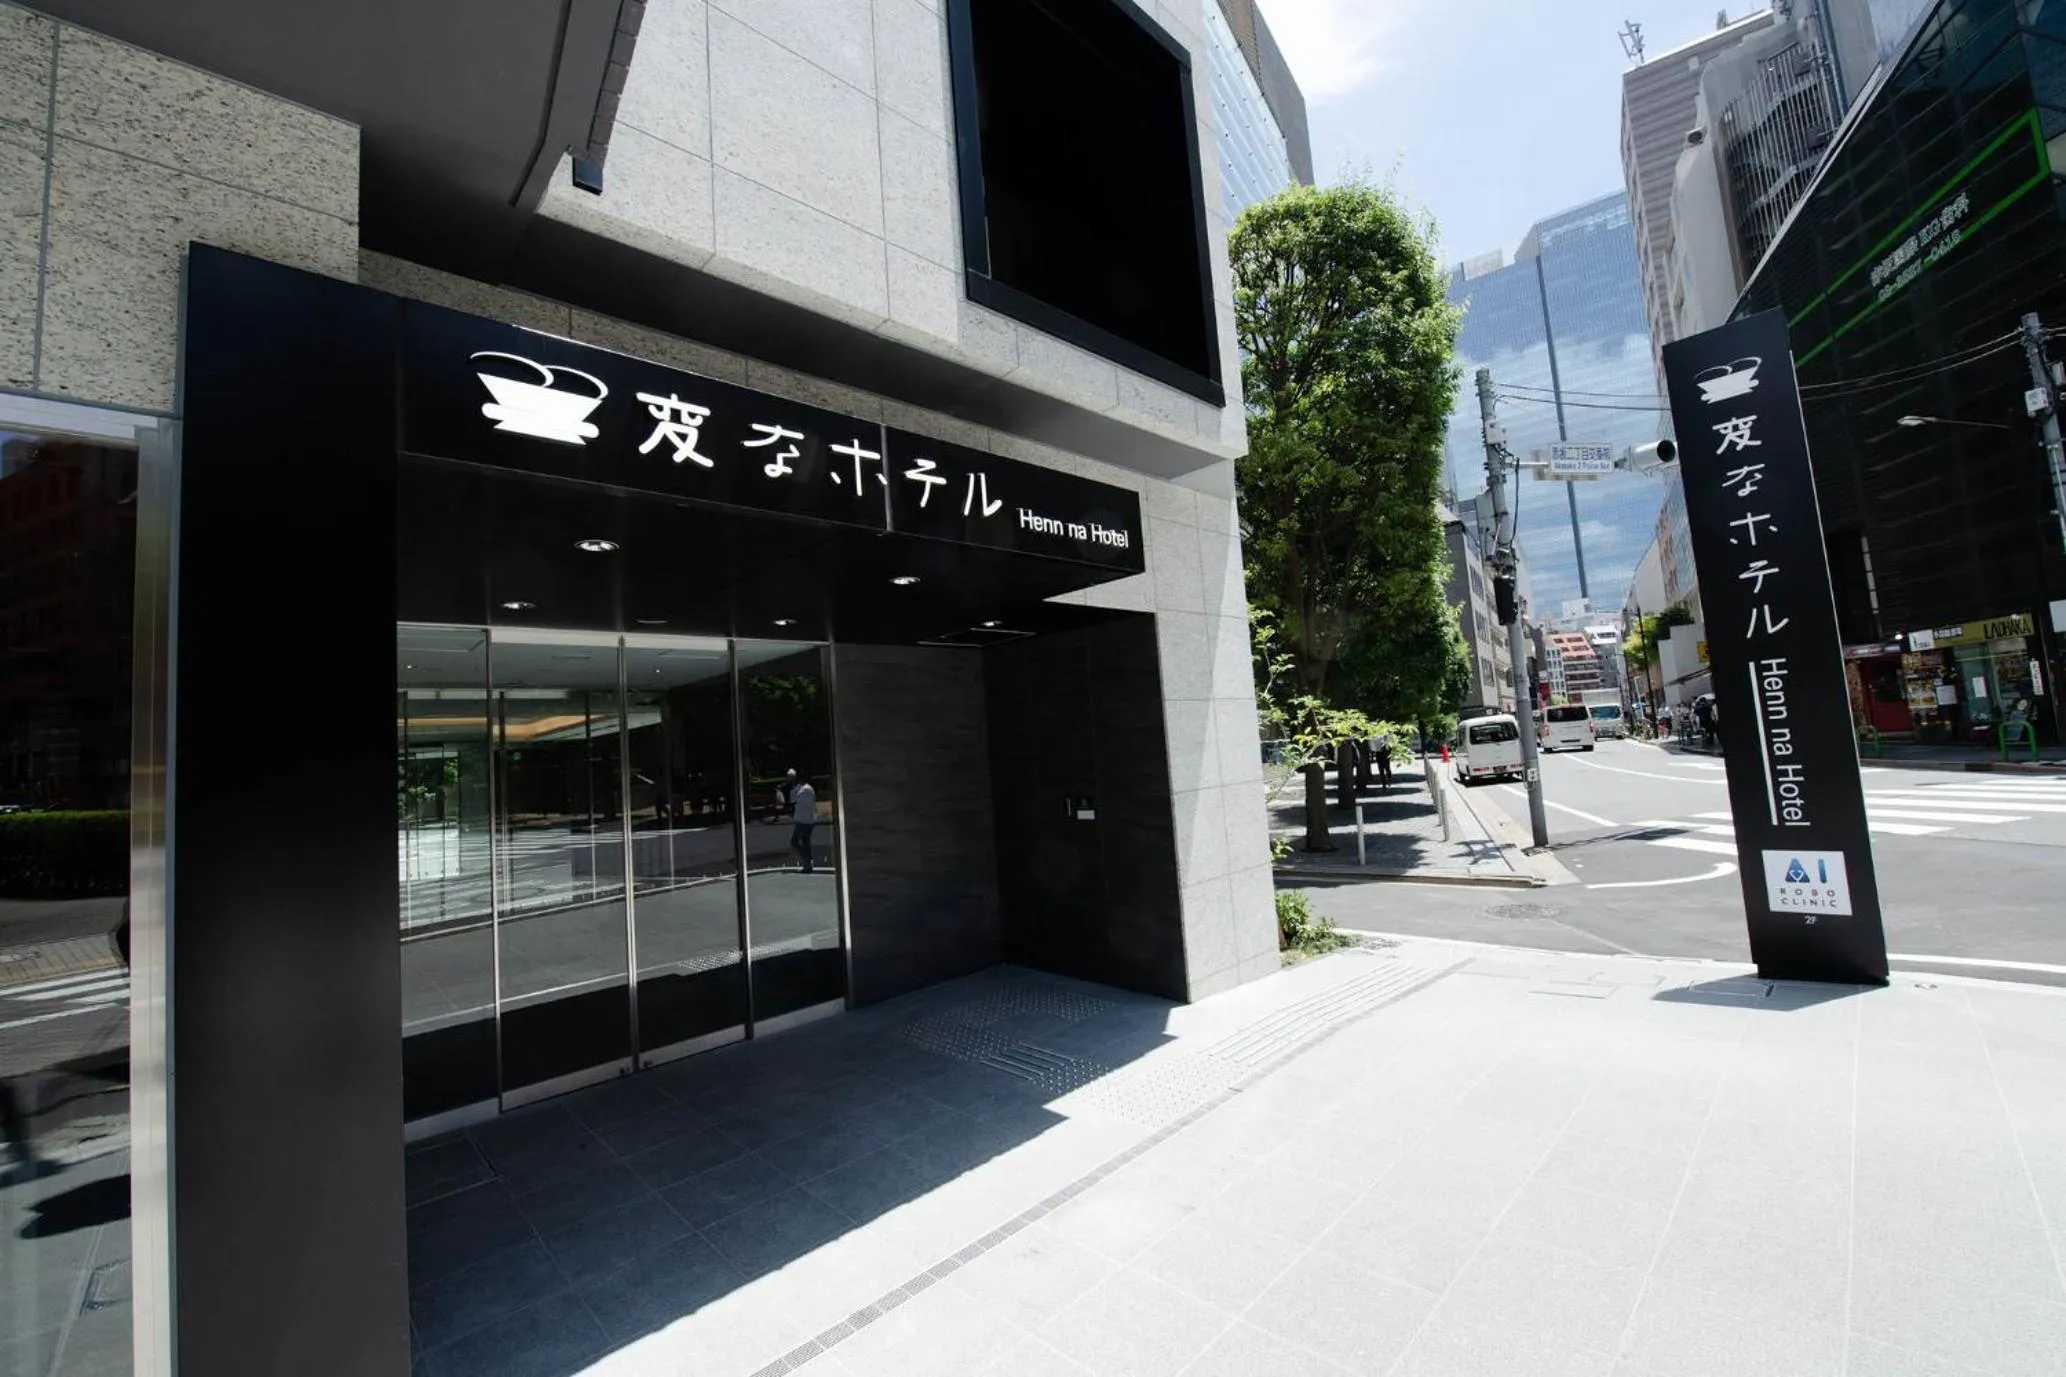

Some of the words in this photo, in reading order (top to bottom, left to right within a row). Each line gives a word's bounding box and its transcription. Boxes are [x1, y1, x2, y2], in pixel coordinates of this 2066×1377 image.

[637, 393, 1001, 516] 変なホテル
[1019, 507, 1064, 536] Henn
[1068, 523, 1087, 540] na
[1090, 523, 1129, 548] Hotel
[1712, 415, 1789, 638] 変なホテル
[1760, 658, 1789, 720] Henn
[1771, 728, 1793, 756] na
[1776, 765, 1811, 826] Hotel
[1785, 858, 1827, 884] AI
[1780, 888, 1835, 897] ROBO
[1781, 898, 1837, 907] CLINIC
